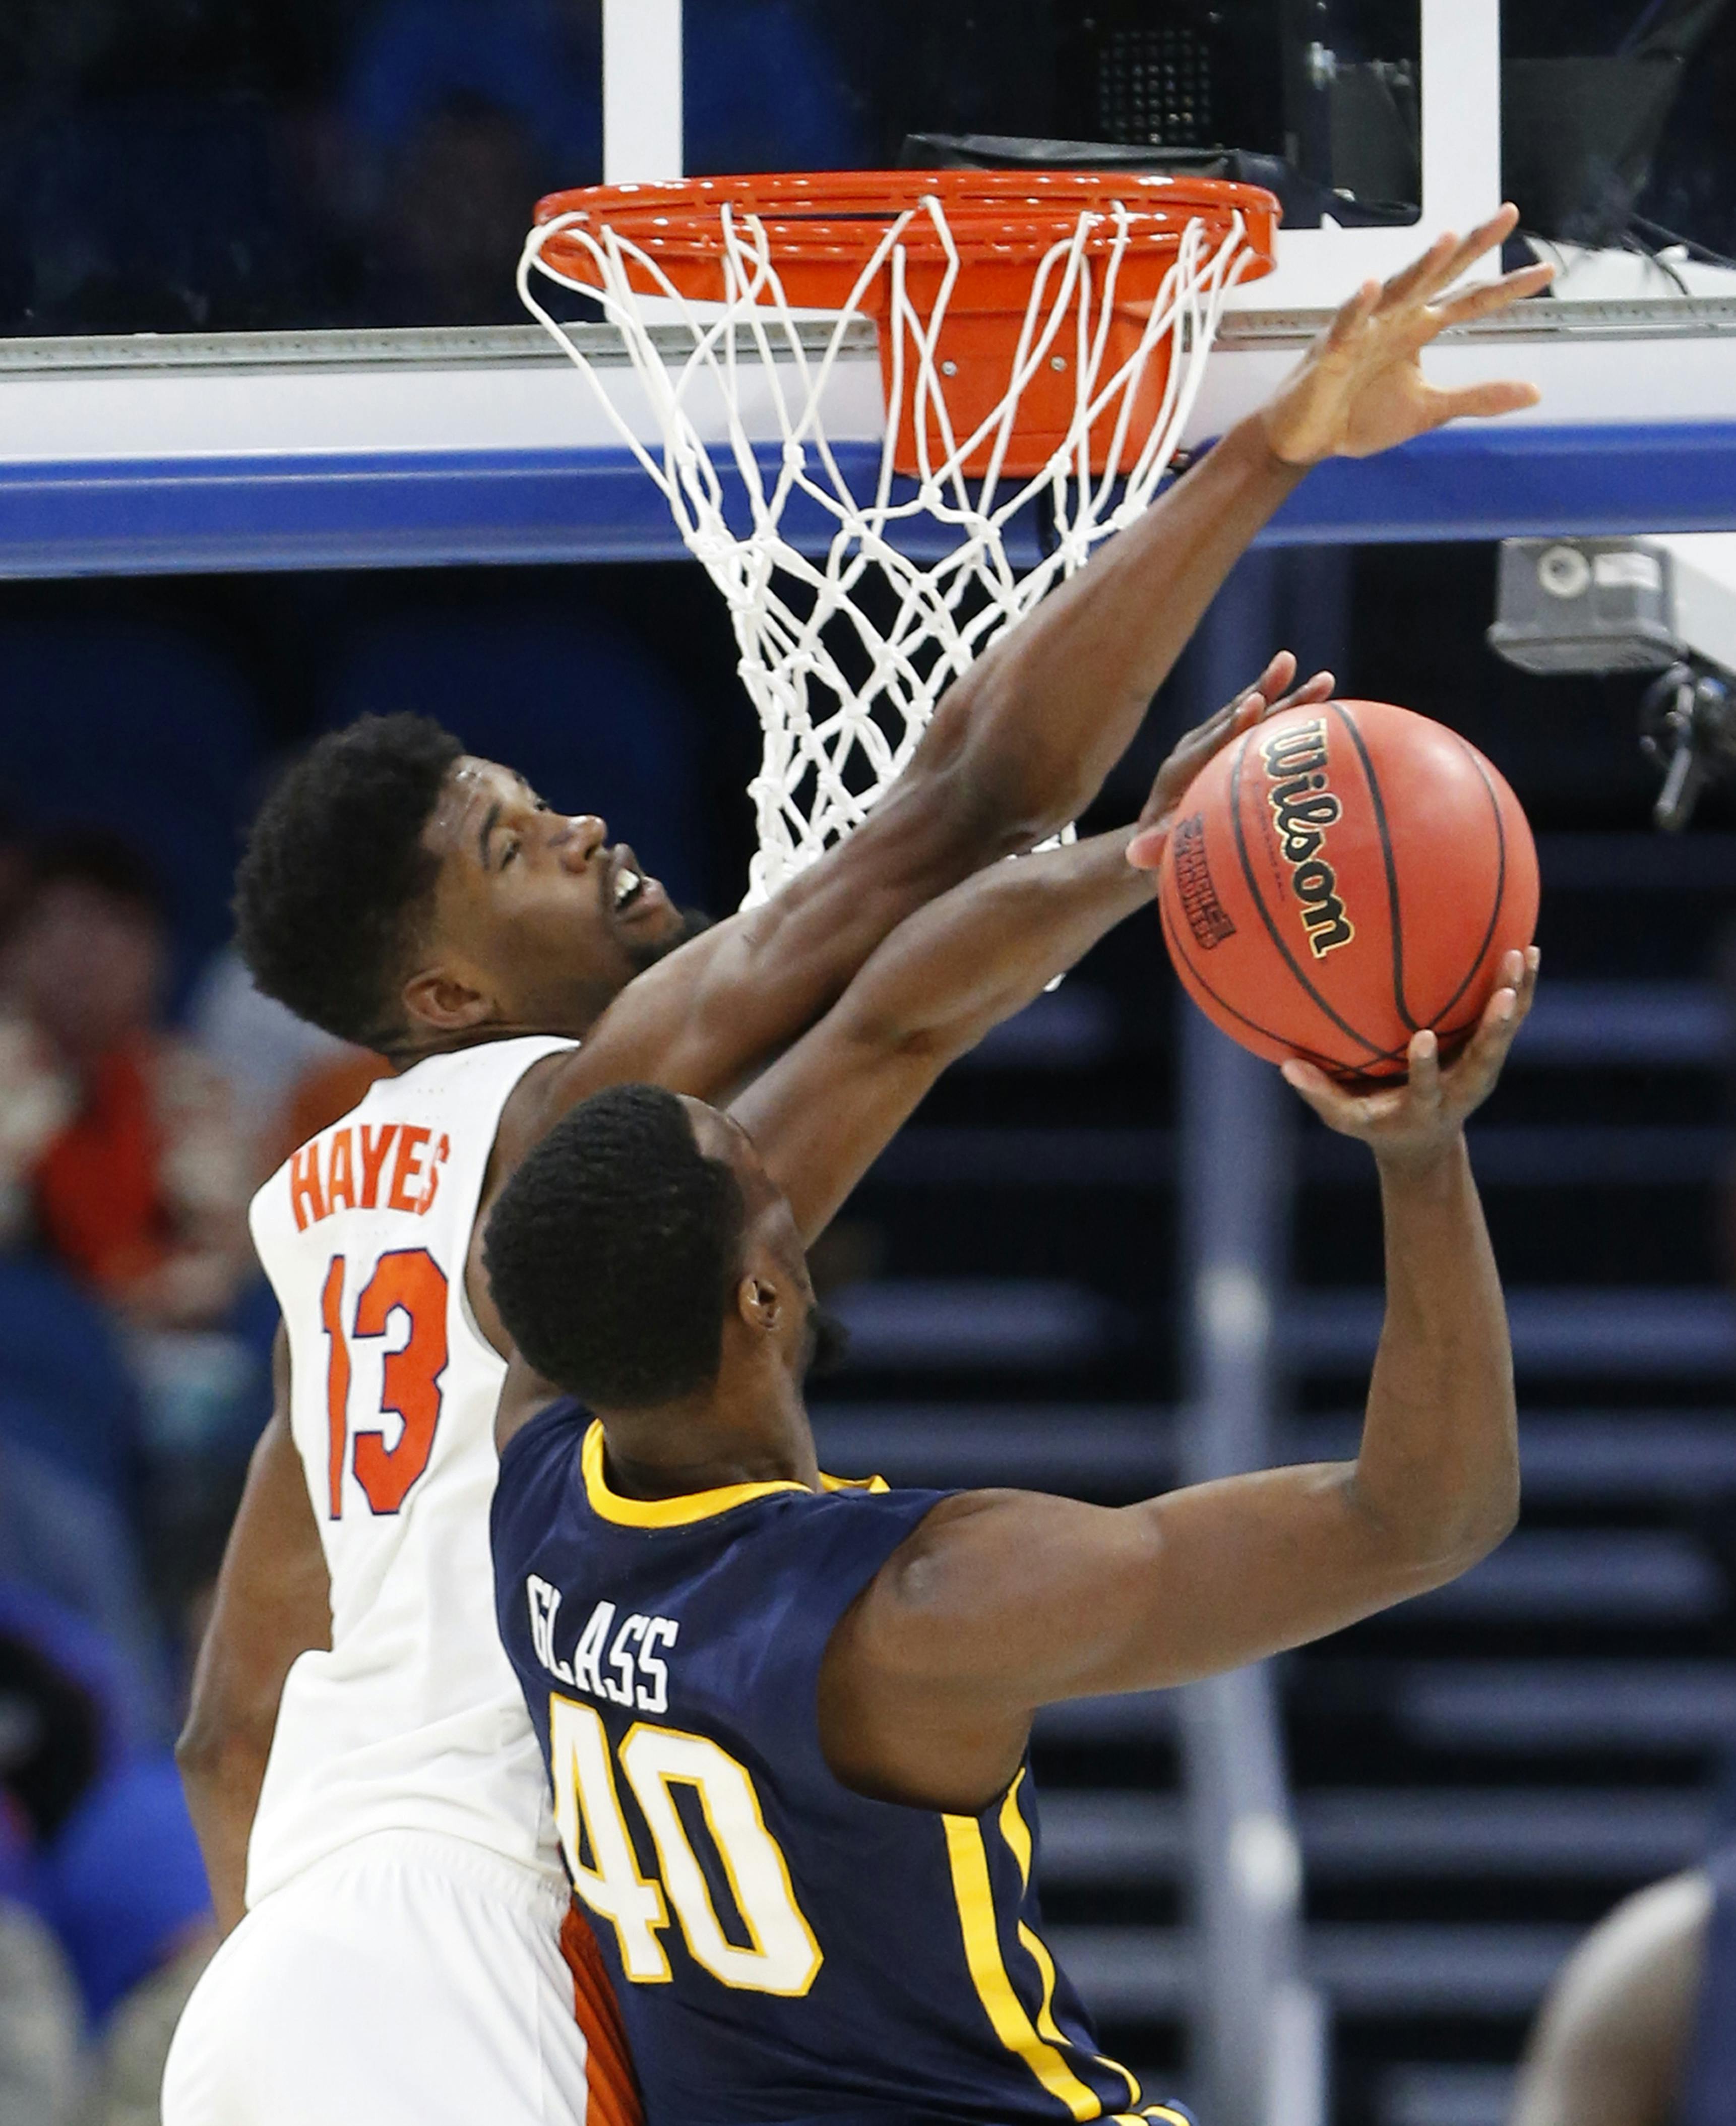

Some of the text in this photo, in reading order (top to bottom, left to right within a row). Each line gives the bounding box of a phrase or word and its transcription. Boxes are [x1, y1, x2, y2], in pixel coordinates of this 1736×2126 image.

[1263, 718, 1355, 959] Wilson
[290, 1124, 450, 1233] HAYES
[321, 1247, 448, 1520] 13
[526, 1573, 678, 1713] GLASS
[550, 1691, 824, 1997] 40
